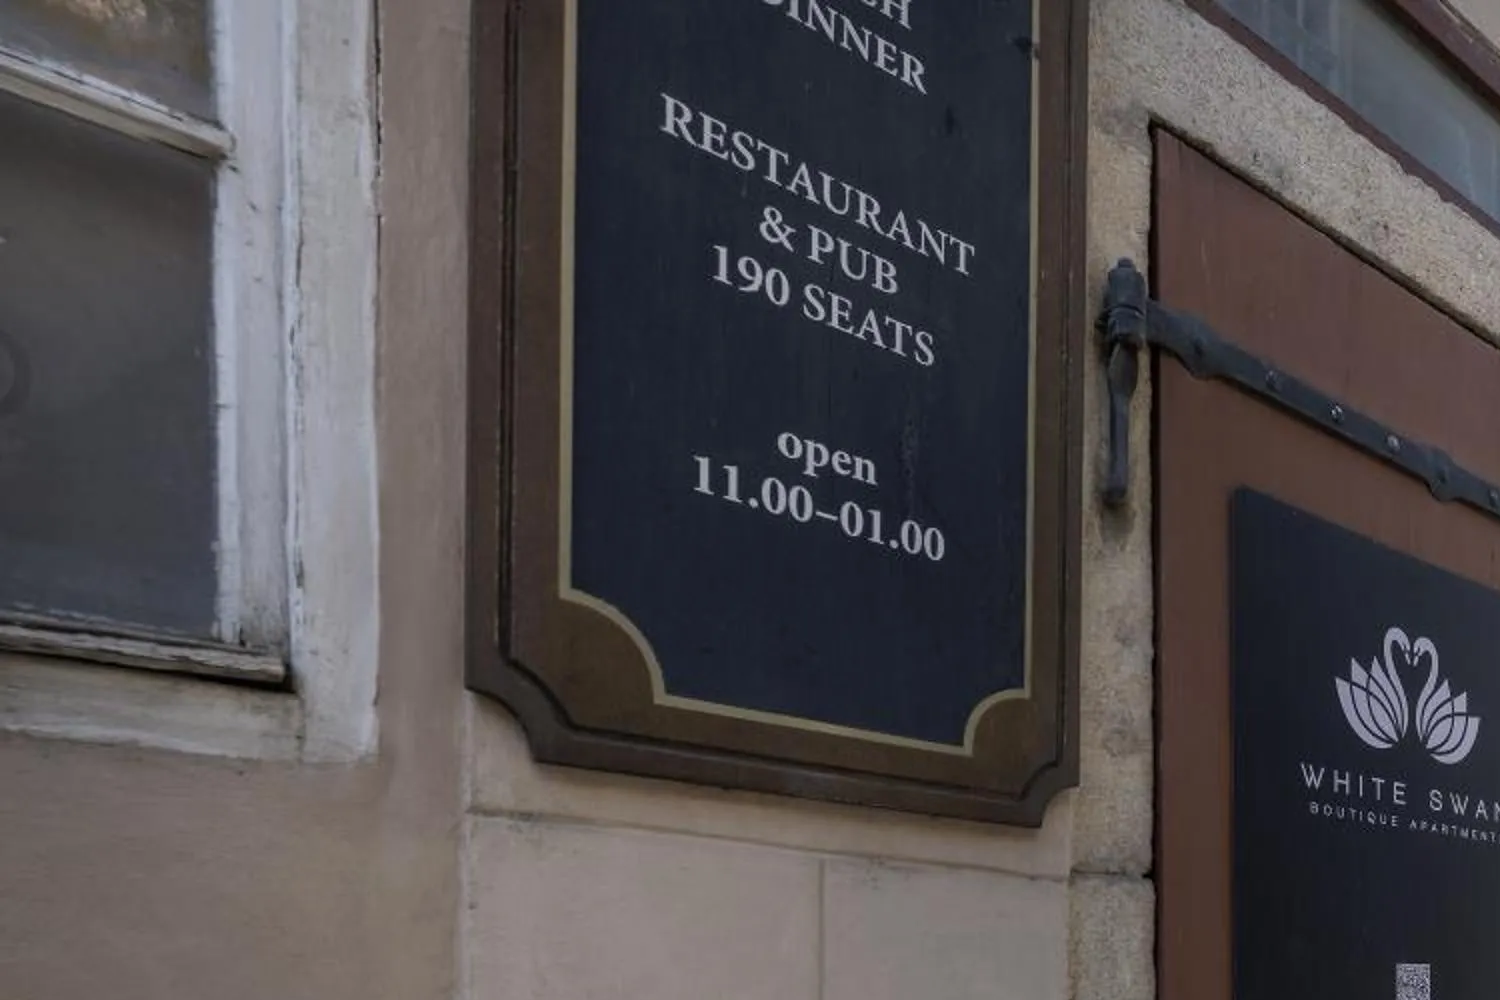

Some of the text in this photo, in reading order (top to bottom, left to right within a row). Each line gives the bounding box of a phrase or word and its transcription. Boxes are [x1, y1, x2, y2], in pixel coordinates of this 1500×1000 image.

[763, 0, 927, 94] INNER
[660, 93, 975, 276] RESTAURANT
[759, 205, 899, 294] & PUB
[711, 245, 935, 366] 190 SEATS
[777, 432, 878, 486] open
[1301, 762, 1407, 805] WHITE
[1310, 801, 1399, 827] BOUTIQUE
